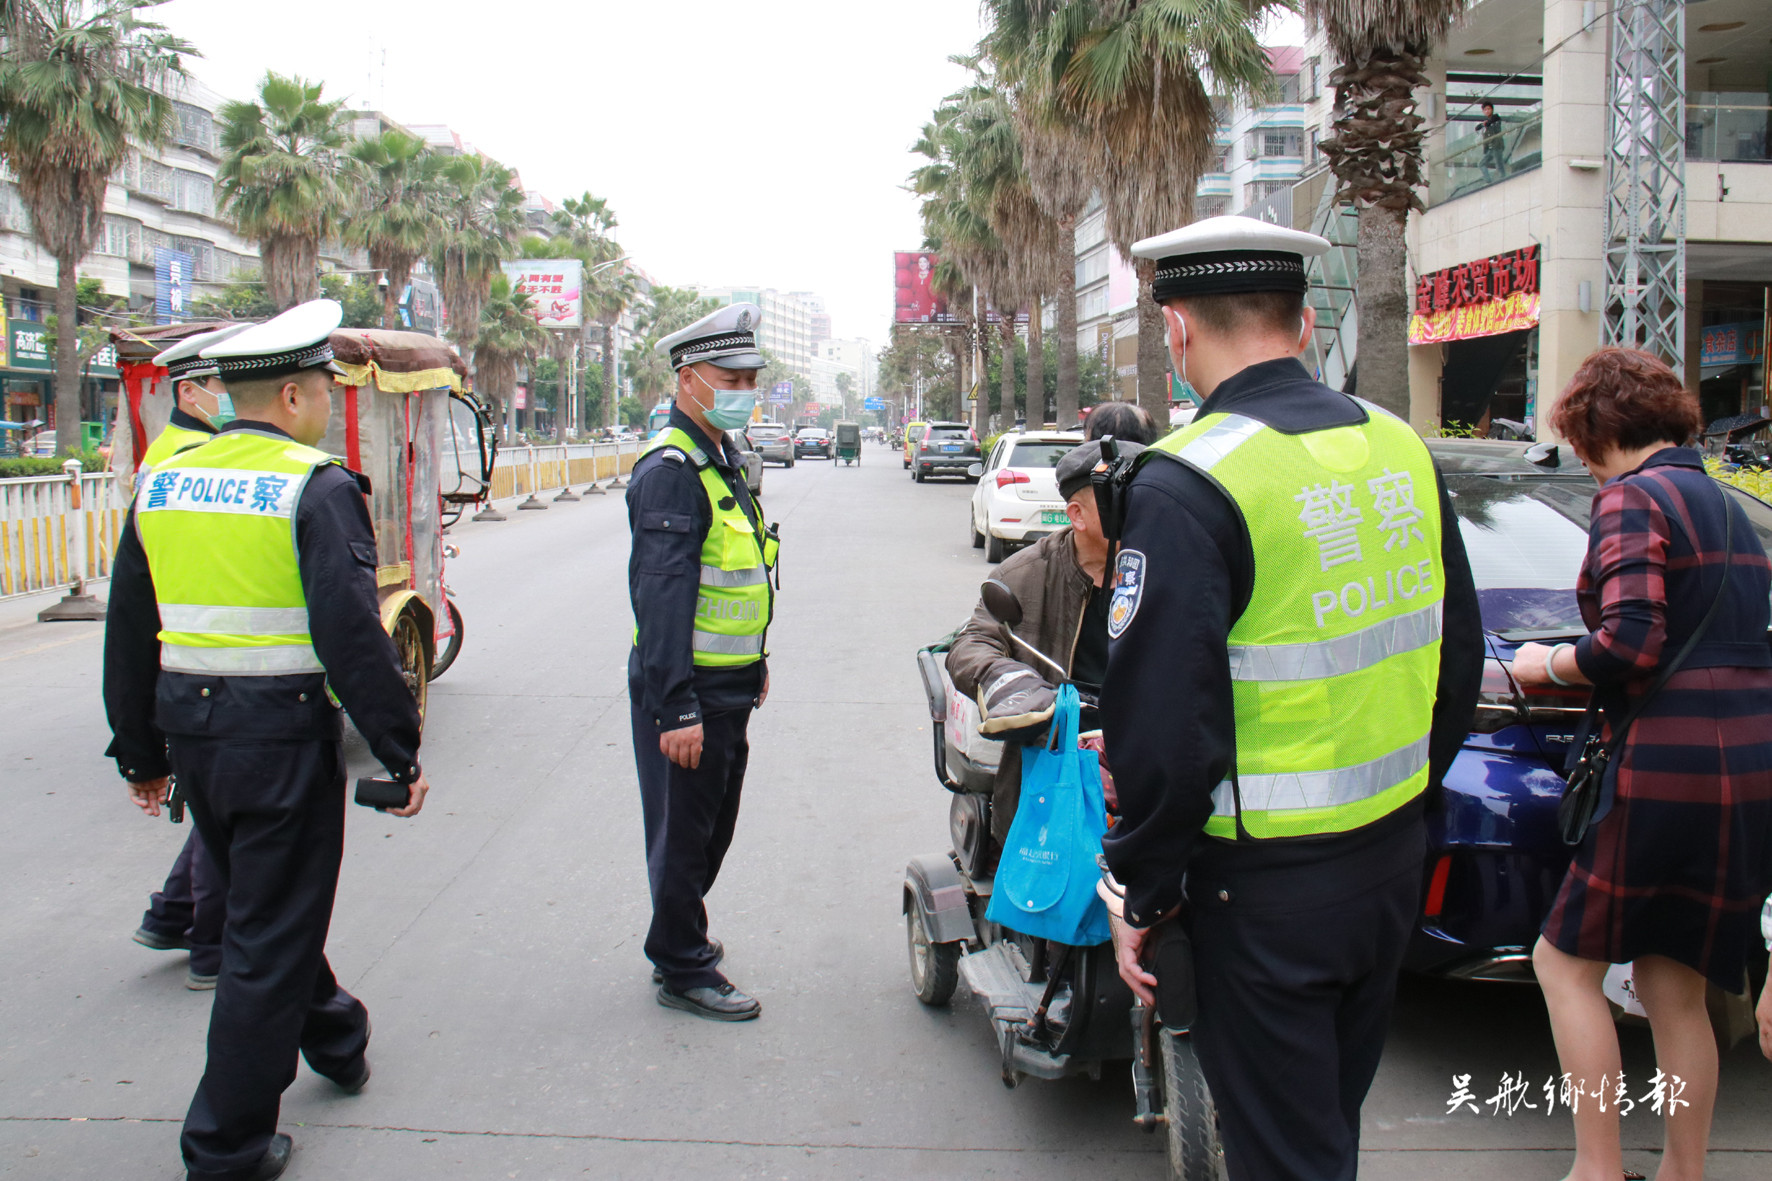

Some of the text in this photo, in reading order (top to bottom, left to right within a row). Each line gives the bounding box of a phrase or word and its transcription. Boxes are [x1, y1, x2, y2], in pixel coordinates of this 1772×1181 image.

[516, 274, 564, 283] 人间有爱
[1416, 245, 1538, 314] 金峰农贸市场
[147, 472, 181, 509] 警
[177, 476, 249, 504] POLICE
[250, 474, 289, 512] 察
[1293, 467, 1425, 573] 警察
[695, 596, 760, 621] ZHIQIN
[1311, 558, 1433, 628] POLICE
[679, 711, 697, 722] POLICE
